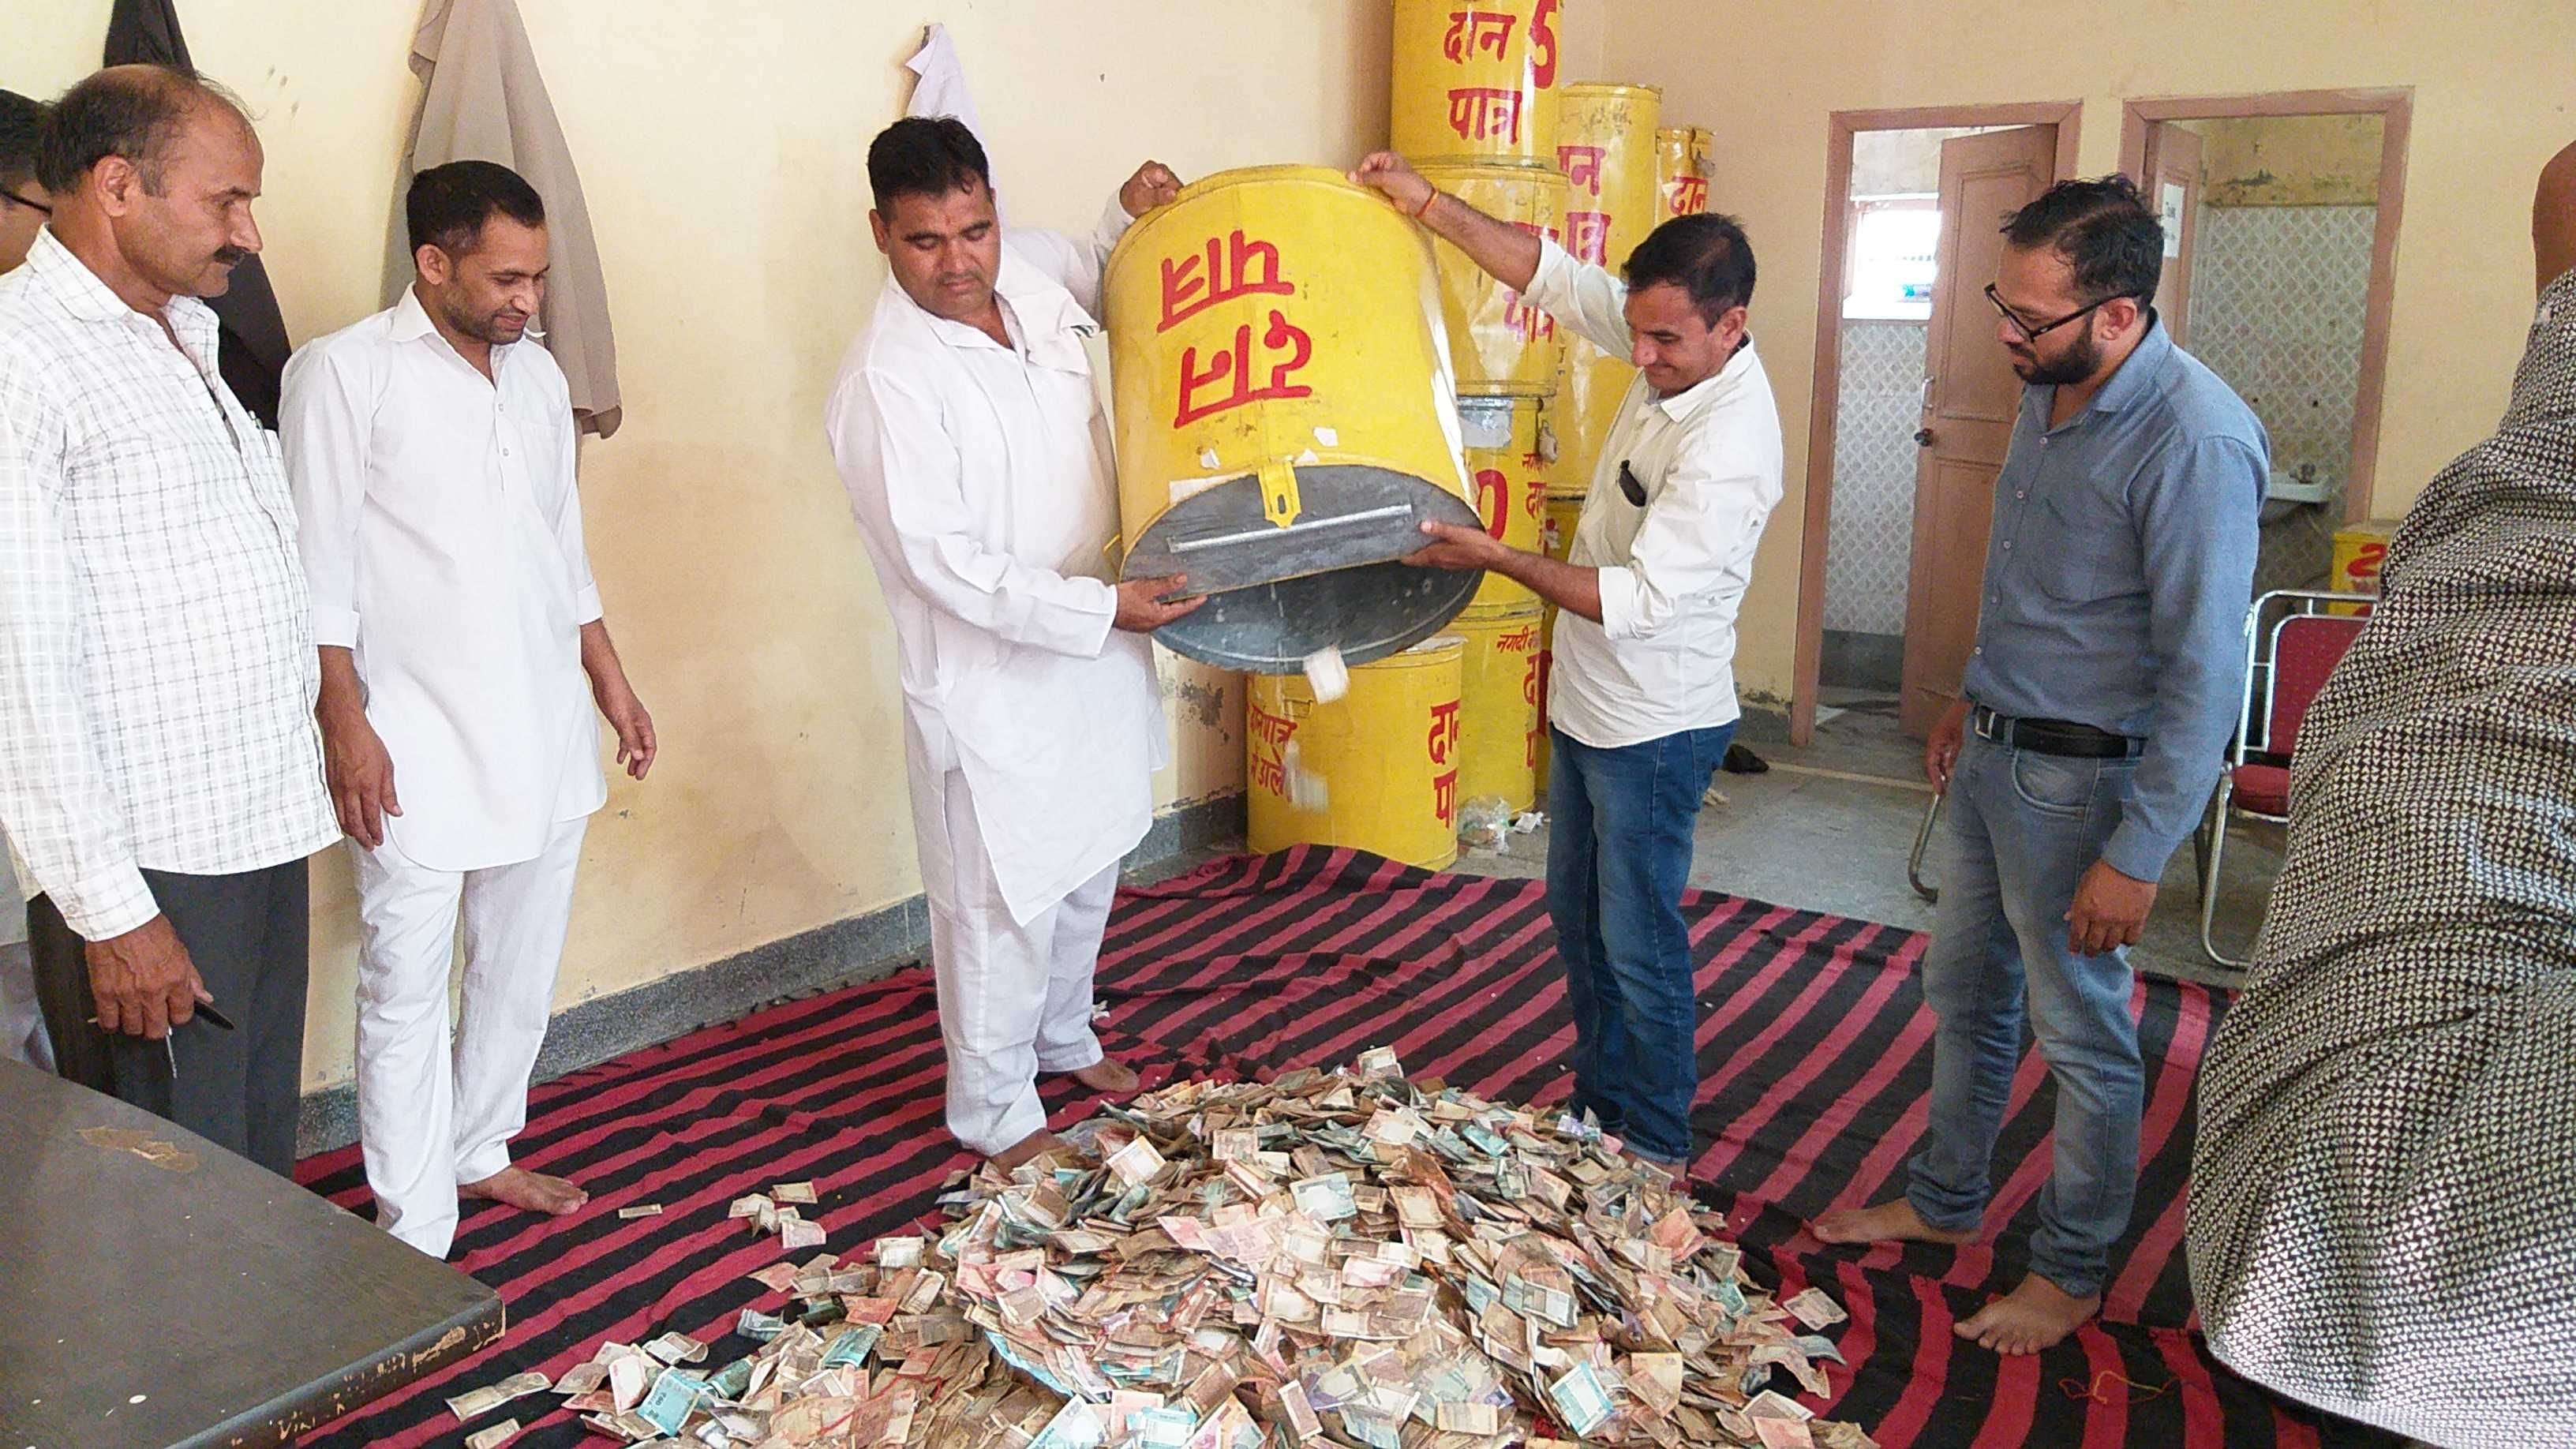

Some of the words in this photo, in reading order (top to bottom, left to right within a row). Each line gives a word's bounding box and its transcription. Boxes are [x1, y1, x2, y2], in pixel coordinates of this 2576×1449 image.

[1443, 11, 1516, 65] दान
[1447, 88, 1522, 144] पात्र
[1157, 230, 1294, 333] पात्र
[1174, 309, 1312, 429] दान
